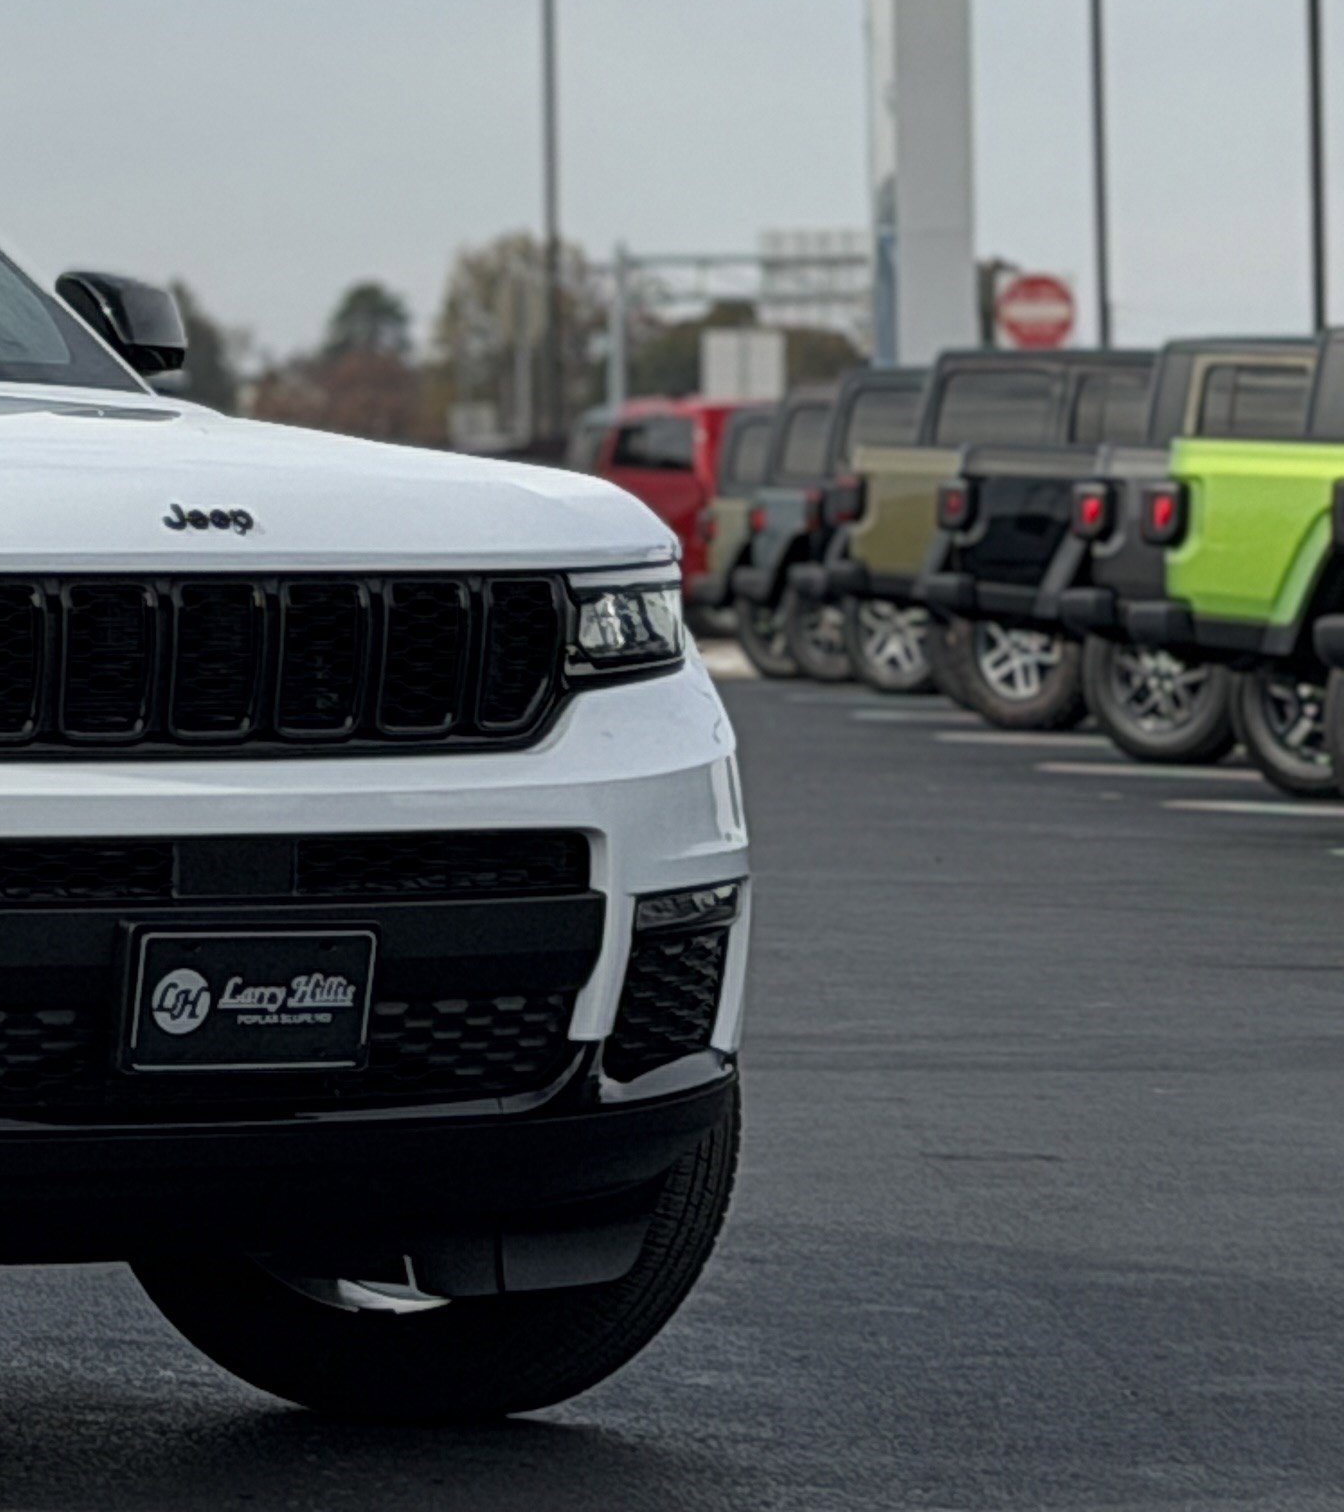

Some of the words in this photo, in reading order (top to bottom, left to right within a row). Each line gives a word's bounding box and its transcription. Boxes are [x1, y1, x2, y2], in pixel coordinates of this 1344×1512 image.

[163, 503, 254, 536] Jeep
[217, 976, 287, 1013] Larry
[287, 972, 356, 1008] Hillis
